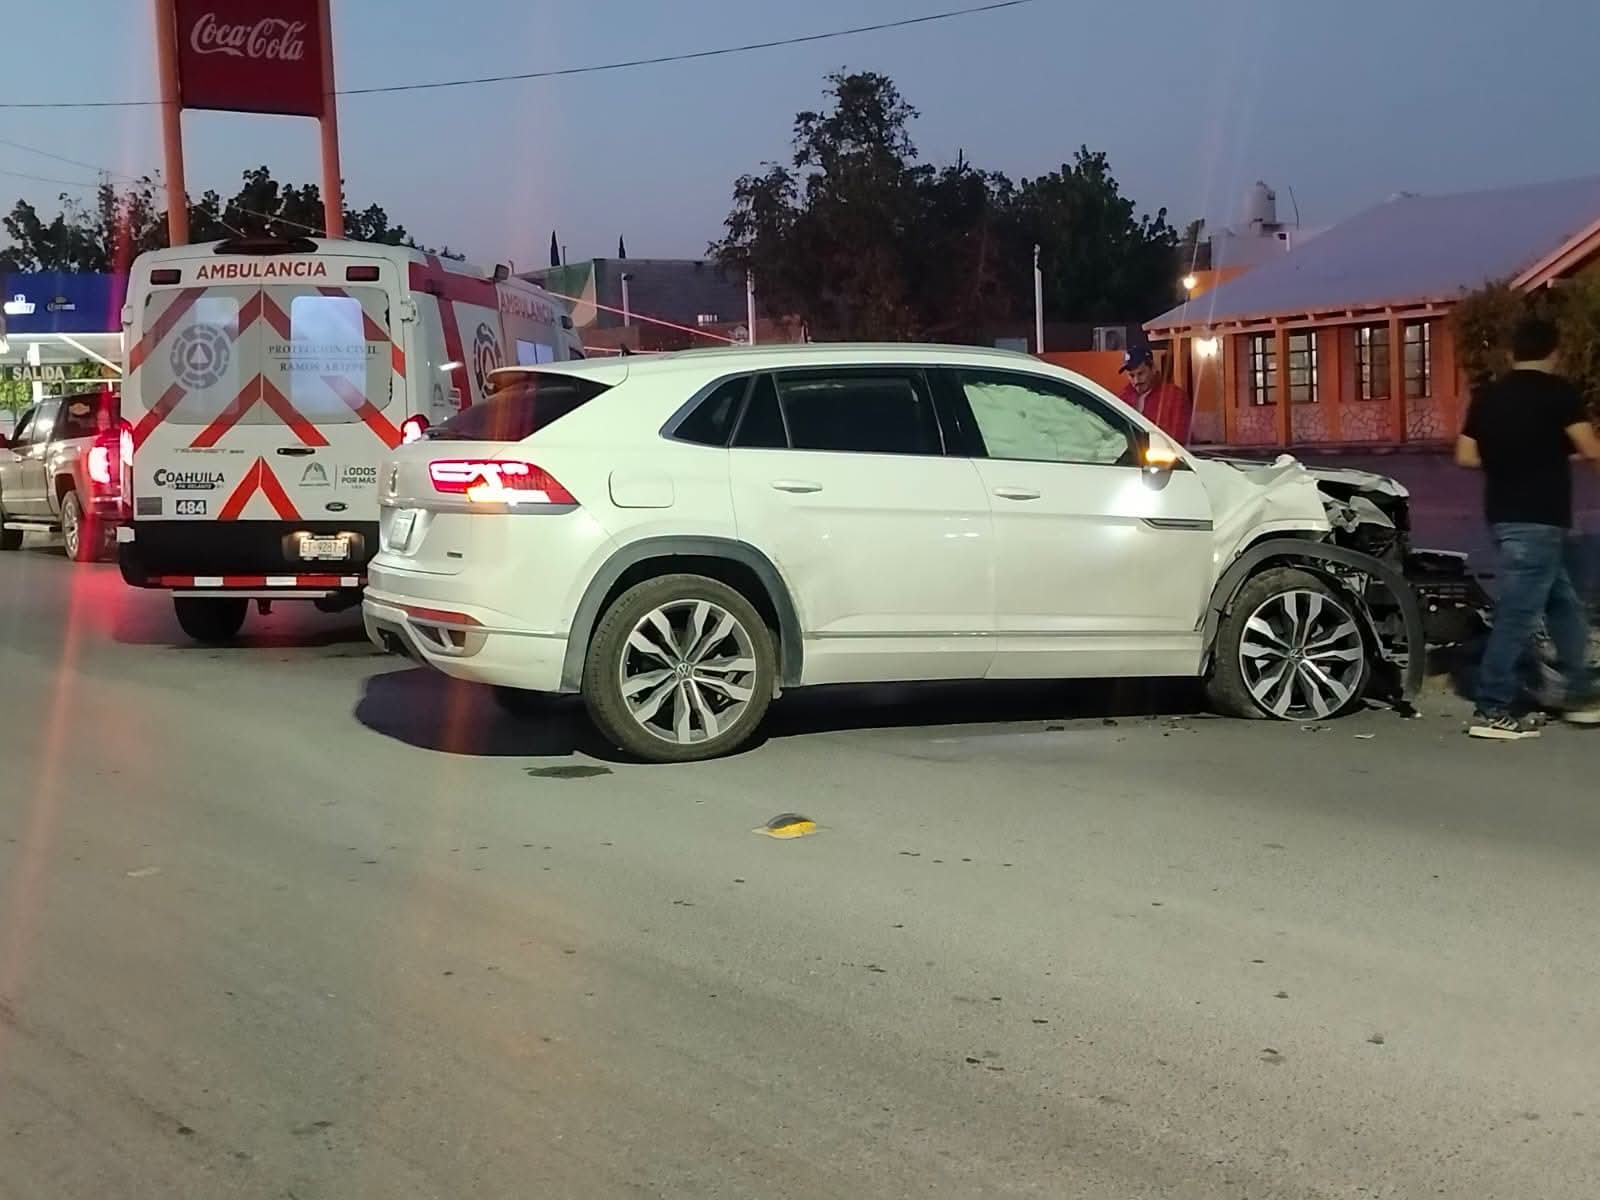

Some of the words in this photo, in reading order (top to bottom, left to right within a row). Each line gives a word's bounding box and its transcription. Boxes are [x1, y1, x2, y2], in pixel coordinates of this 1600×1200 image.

[190, 12, 307, 60] Coca-Cola
[196, 261, 327, 280] AMBULANCIA
[13, 366, 65, 380] SALIDA
[153, 468, 225, 486] COAHUILA
[177, 501, 206, 514] 484
